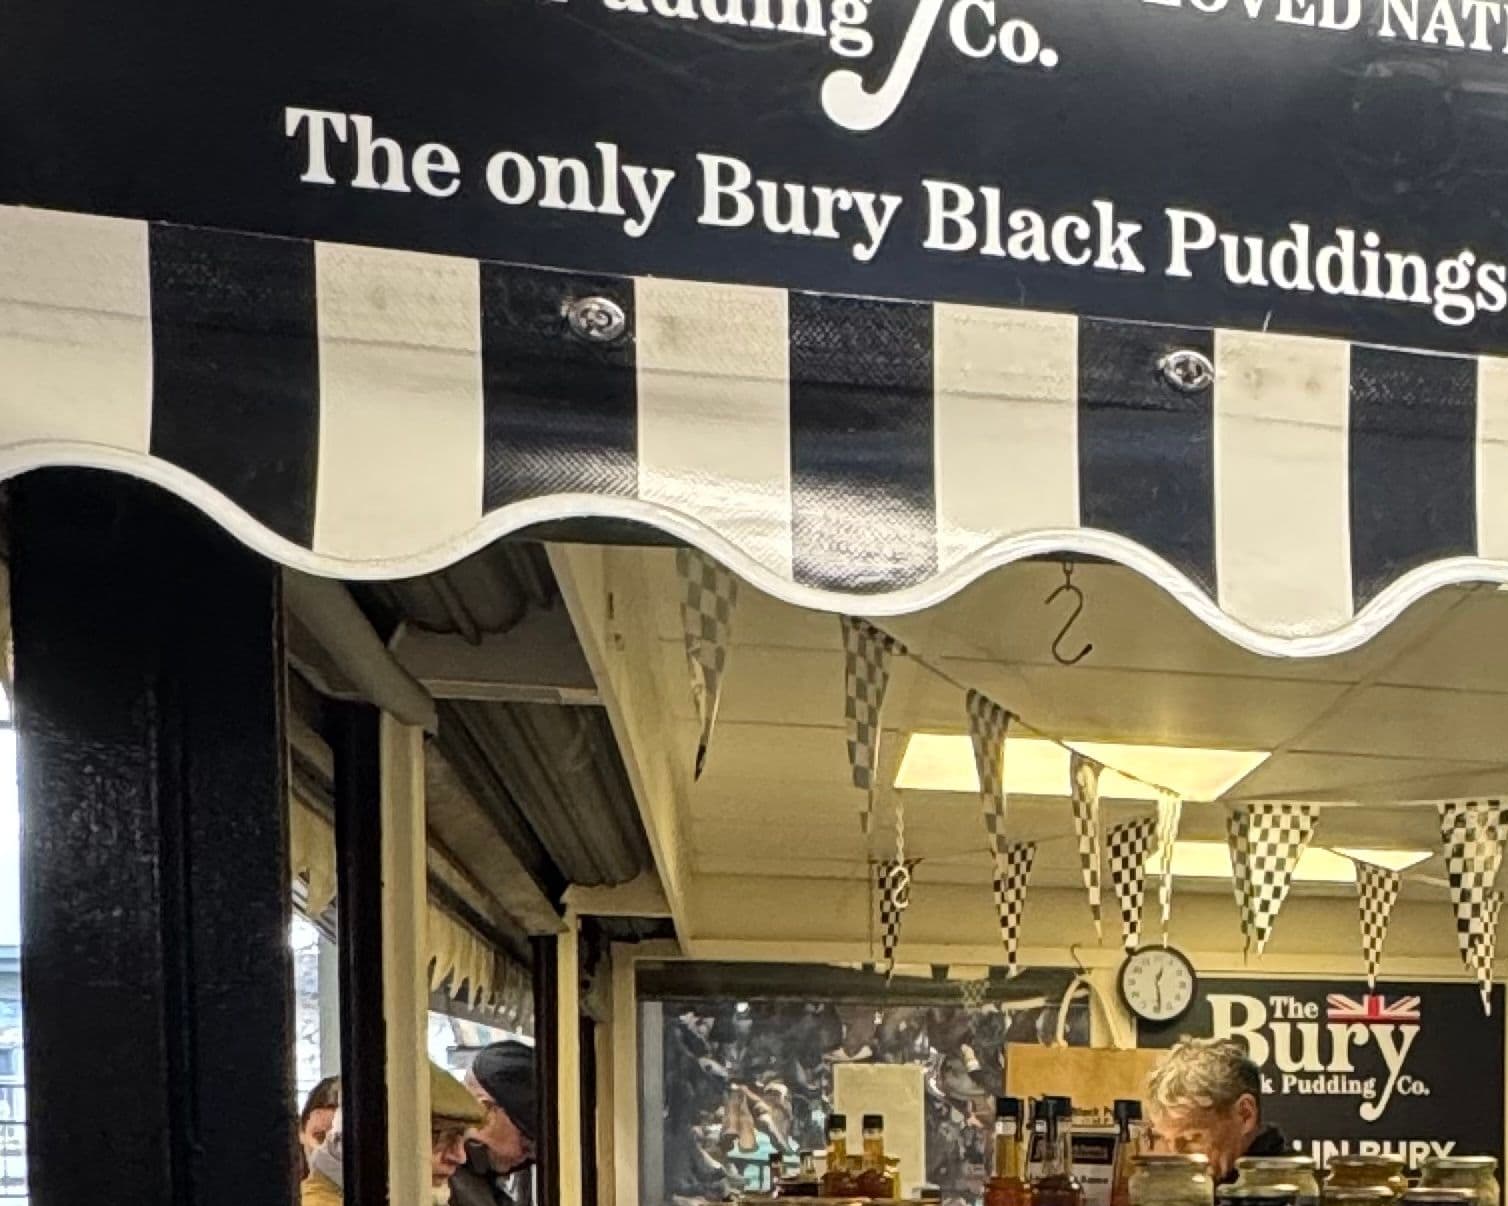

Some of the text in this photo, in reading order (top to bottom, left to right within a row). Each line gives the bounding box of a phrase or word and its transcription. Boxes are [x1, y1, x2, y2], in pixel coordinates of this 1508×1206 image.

[948, 0, 1059, 68] Co.
[284, 106, 461, 199] The
[485, 142, 676, 237] only
[696, 153, 900, 262] Bury
[922, 178, 1146, 273] Black
[1164, 208, 1508, 326] Puddings
[1269, 995, 1319, 1019] The
[1206, 993, 1421, 1121] Bury
[1281, 1075, 1377, 1100] Pudding
[1397, 1075, 1431, 1096] Co.
